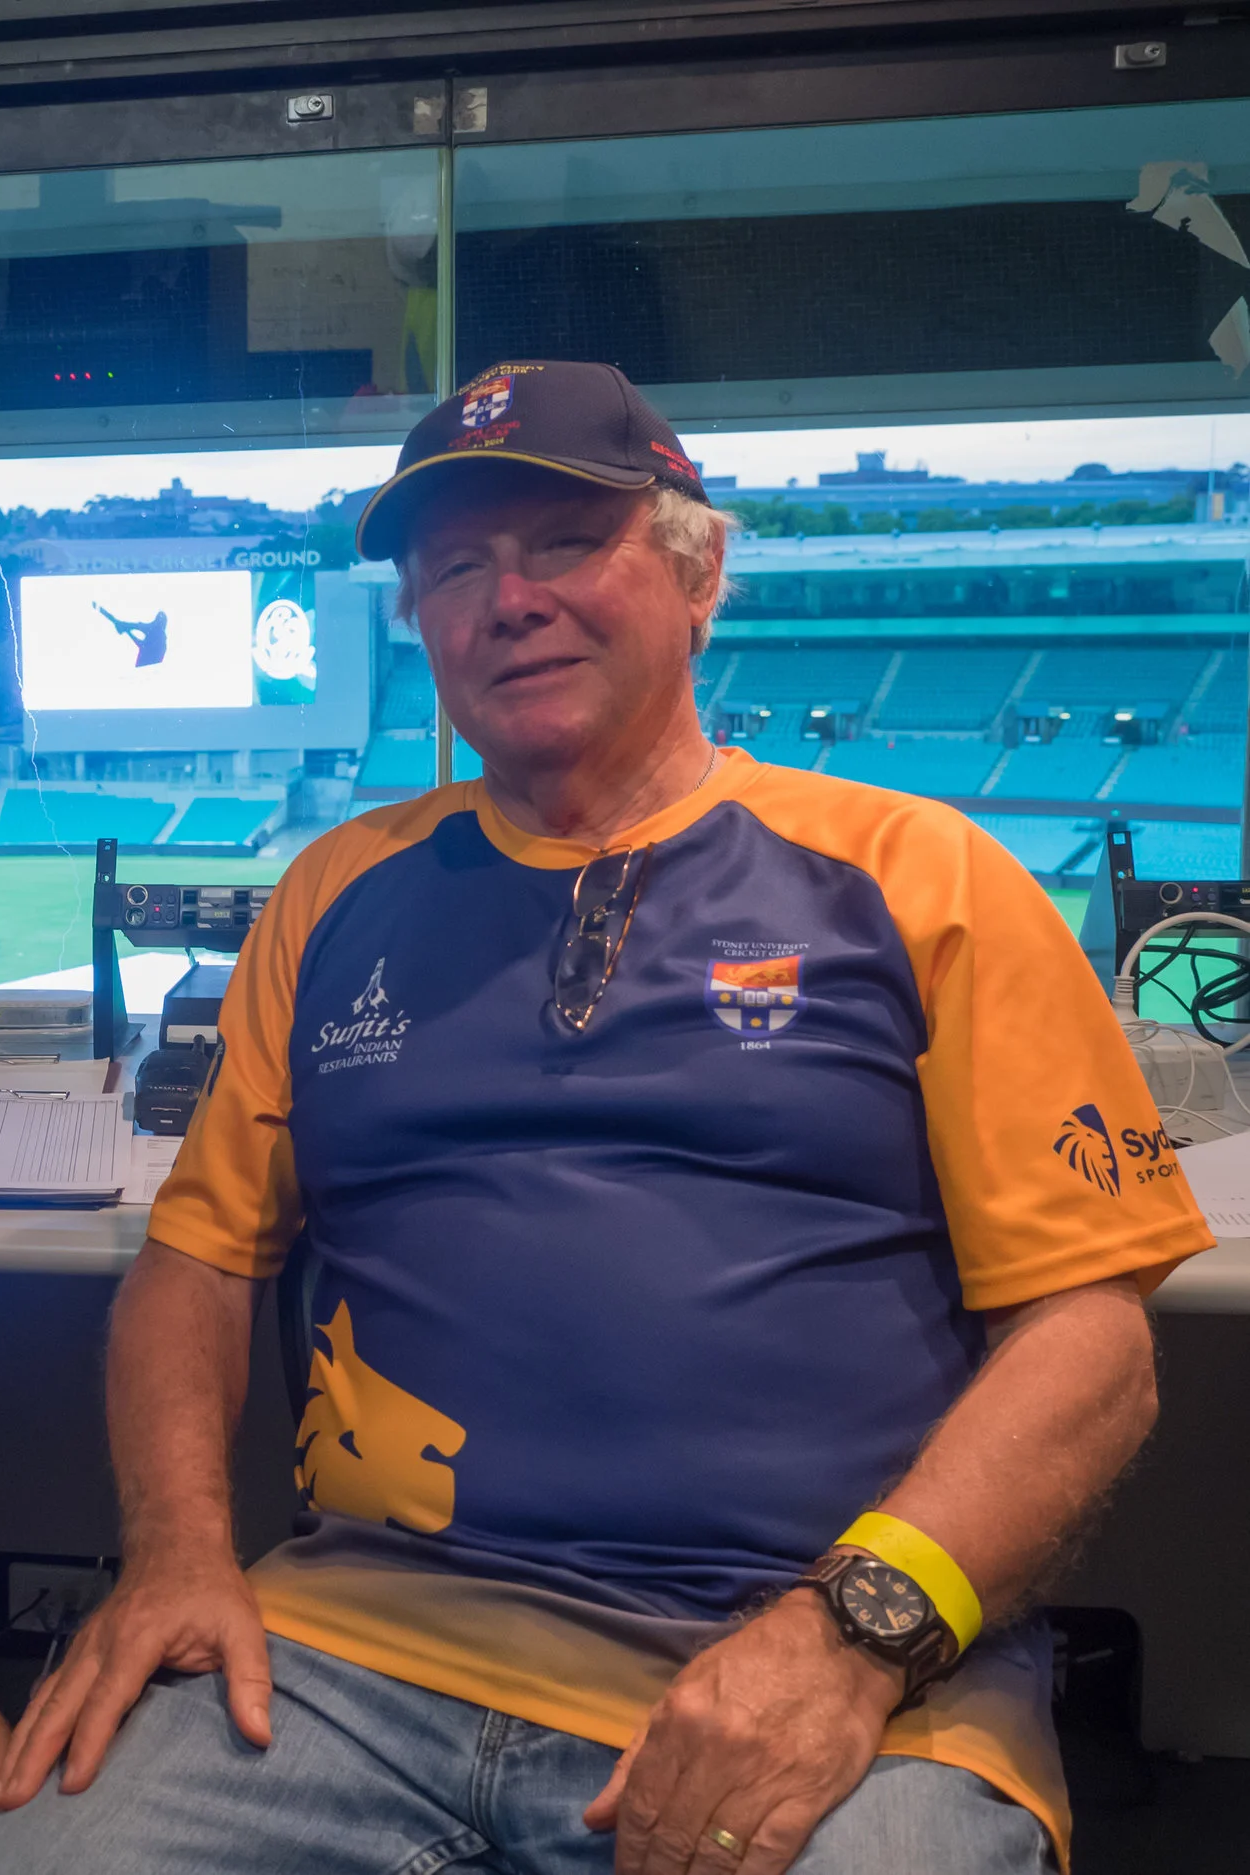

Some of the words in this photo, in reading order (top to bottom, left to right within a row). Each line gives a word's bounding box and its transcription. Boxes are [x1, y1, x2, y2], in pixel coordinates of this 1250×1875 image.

[148, 554, 228, 572] CRICKET
[235, 550, 321, 569] GROUND
[711, 939, 749, 950] SYDNEY
[752, 942, 810, 951] UNIVERSITY
[724, 949, 766, 957] CRICKET
[354, 1039, 403, 1054] INDIAN
[740, 1041, 771, 1050] 1864
[318, 1051, 398, 1074] RESTAURANTS
